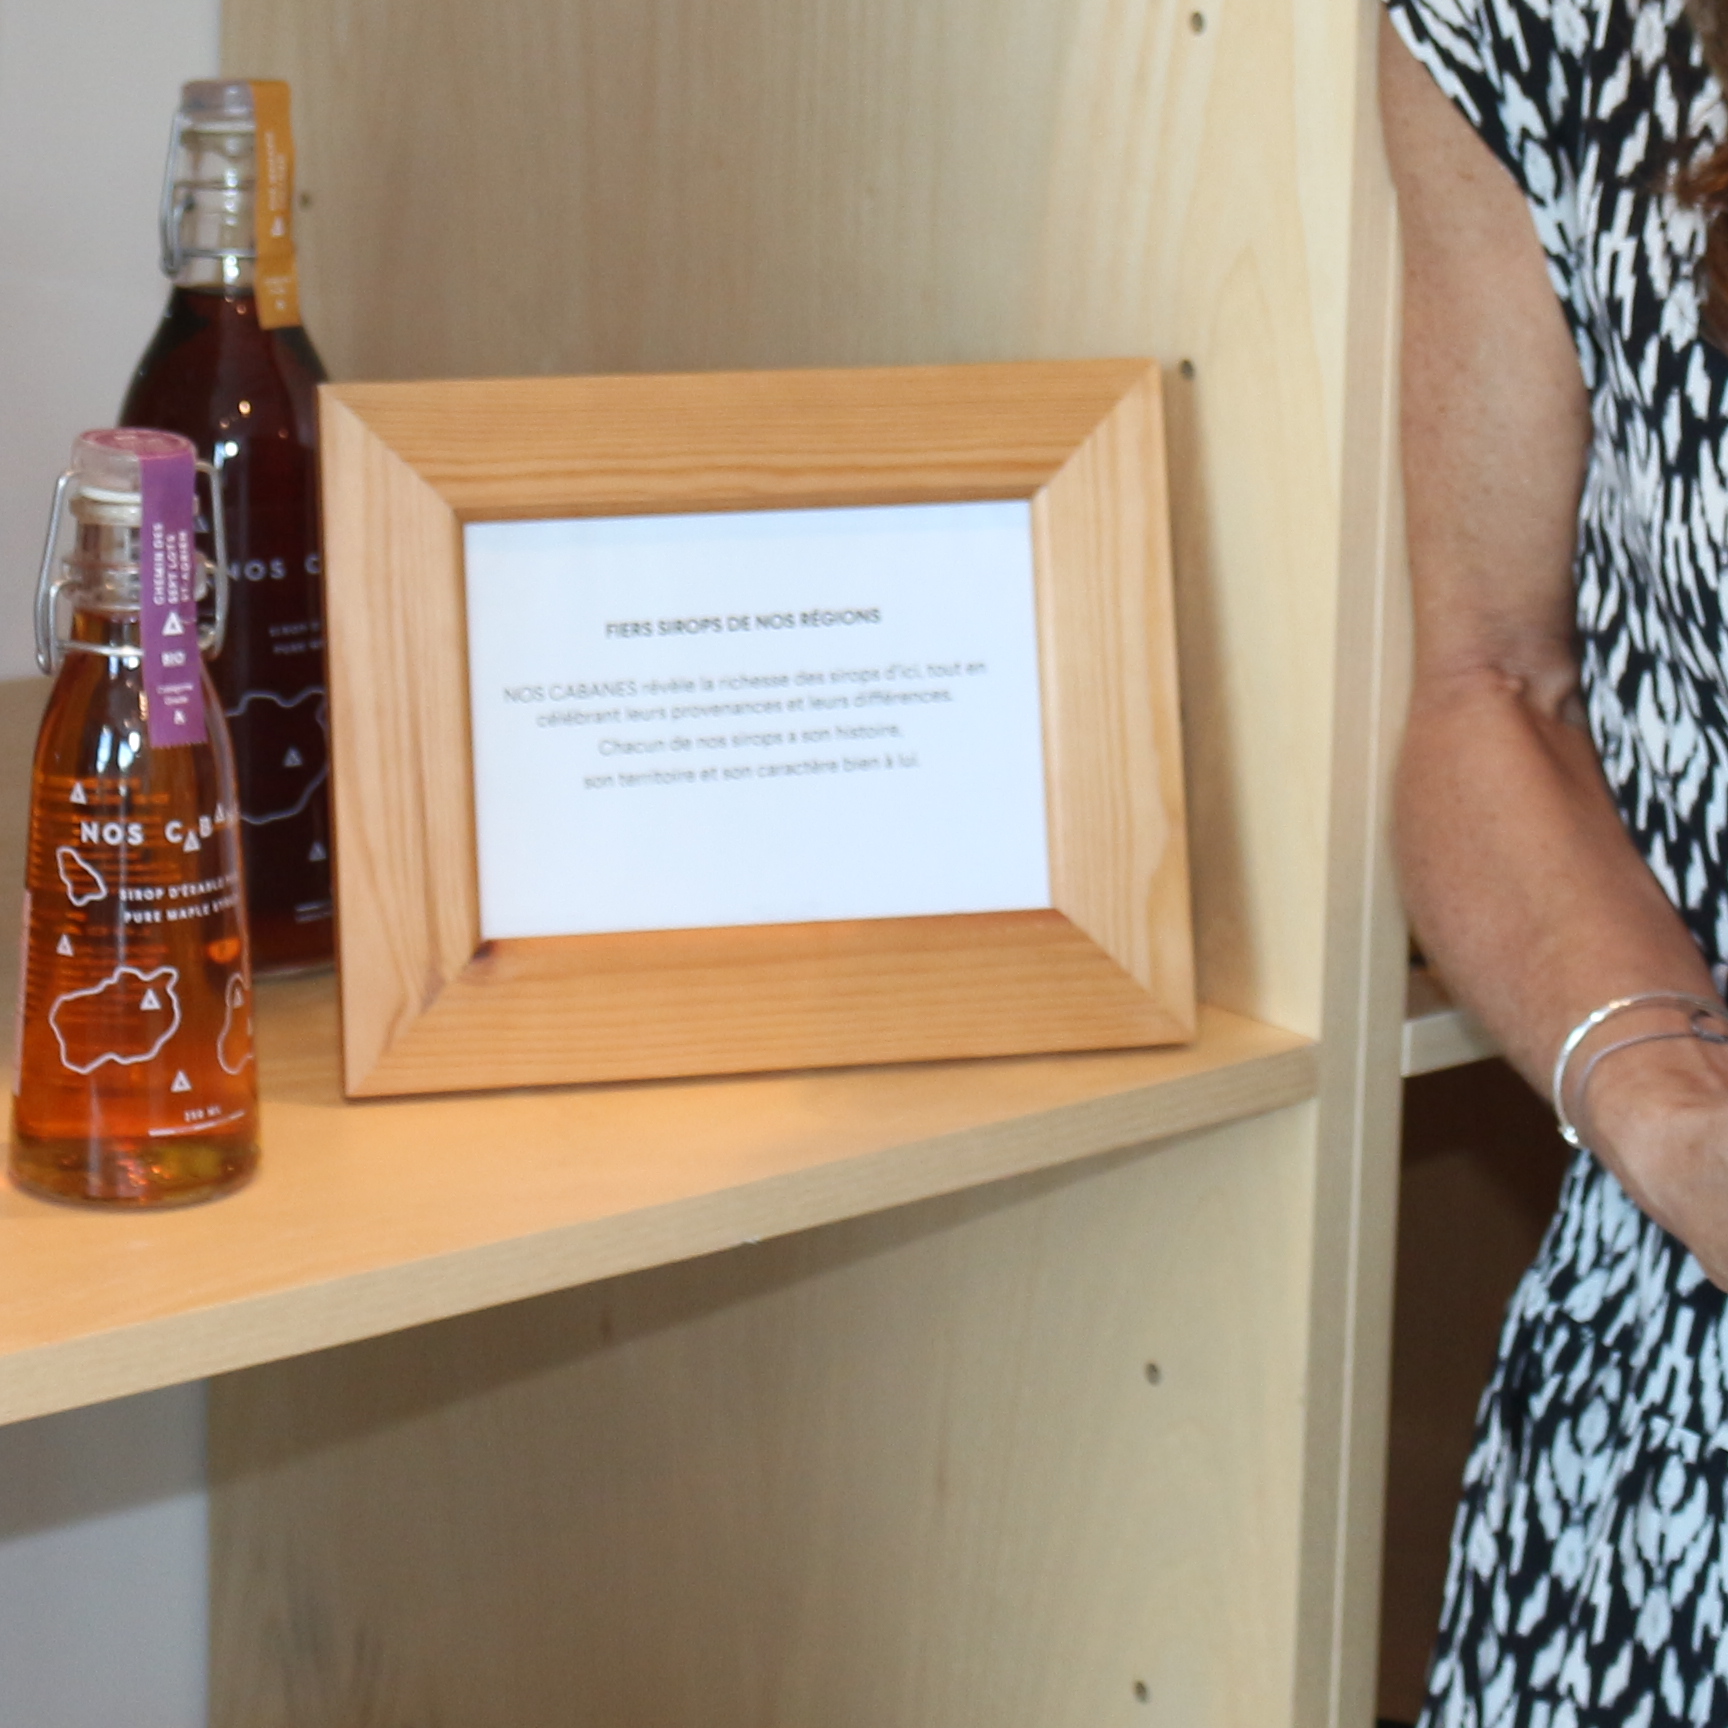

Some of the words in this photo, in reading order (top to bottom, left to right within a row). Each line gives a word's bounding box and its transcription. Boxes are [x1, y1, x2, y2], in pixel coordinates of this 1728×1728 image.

[152, 522, 165, 550] DES
[152, 551, 166, 606] CHEMIN
[606, 621, 653, 638] FIERS
[658, 616, 723, 636] SIROPS
[726, 614, 752, 633] DE
[755, 613, 796, 630] NOS
[799, 607, 882, 628] RÉGIONS
[161, 650, 187, 667] BIO
[503, 685, 546, 704] NOS
[548, 680, 638, 702] CABANES
[700, 675, 715, 691] la
[718, 673, 790, 691] richesse
[794, 671, 825, 686] des
[829, 669, 881, 687] sirops
[926, 662, 962, 678] tout
[965, 662, 986, 676] en
[625, 707, 667, 722] leurs
[671, 700, 783, 721] provenances
[786, 697, 804, 712] et
[807, 694, 849, 710] leurs
[598, 739, 666, 757] Chacun
[670, 736, 692, 752] de
[695, 735, 728, 750] nos
[731, 732, 784, 749] sirops
[801, 729, 831, 743] son
[583, 775, 615, 791] son
[618, 770, 696, 788] territoire
[700, 768, 718, 782] et
[723, 765, 752, 781] son
[842, 756, 881, 772] bien
[80, 821, 145, 846] NOS
[164, 802, 236, 854] CABA
[118, 887, 165, 902] SIROP
[123, 910, 162, 924] PURE
[165, 902, 211, 922] MAPLE
